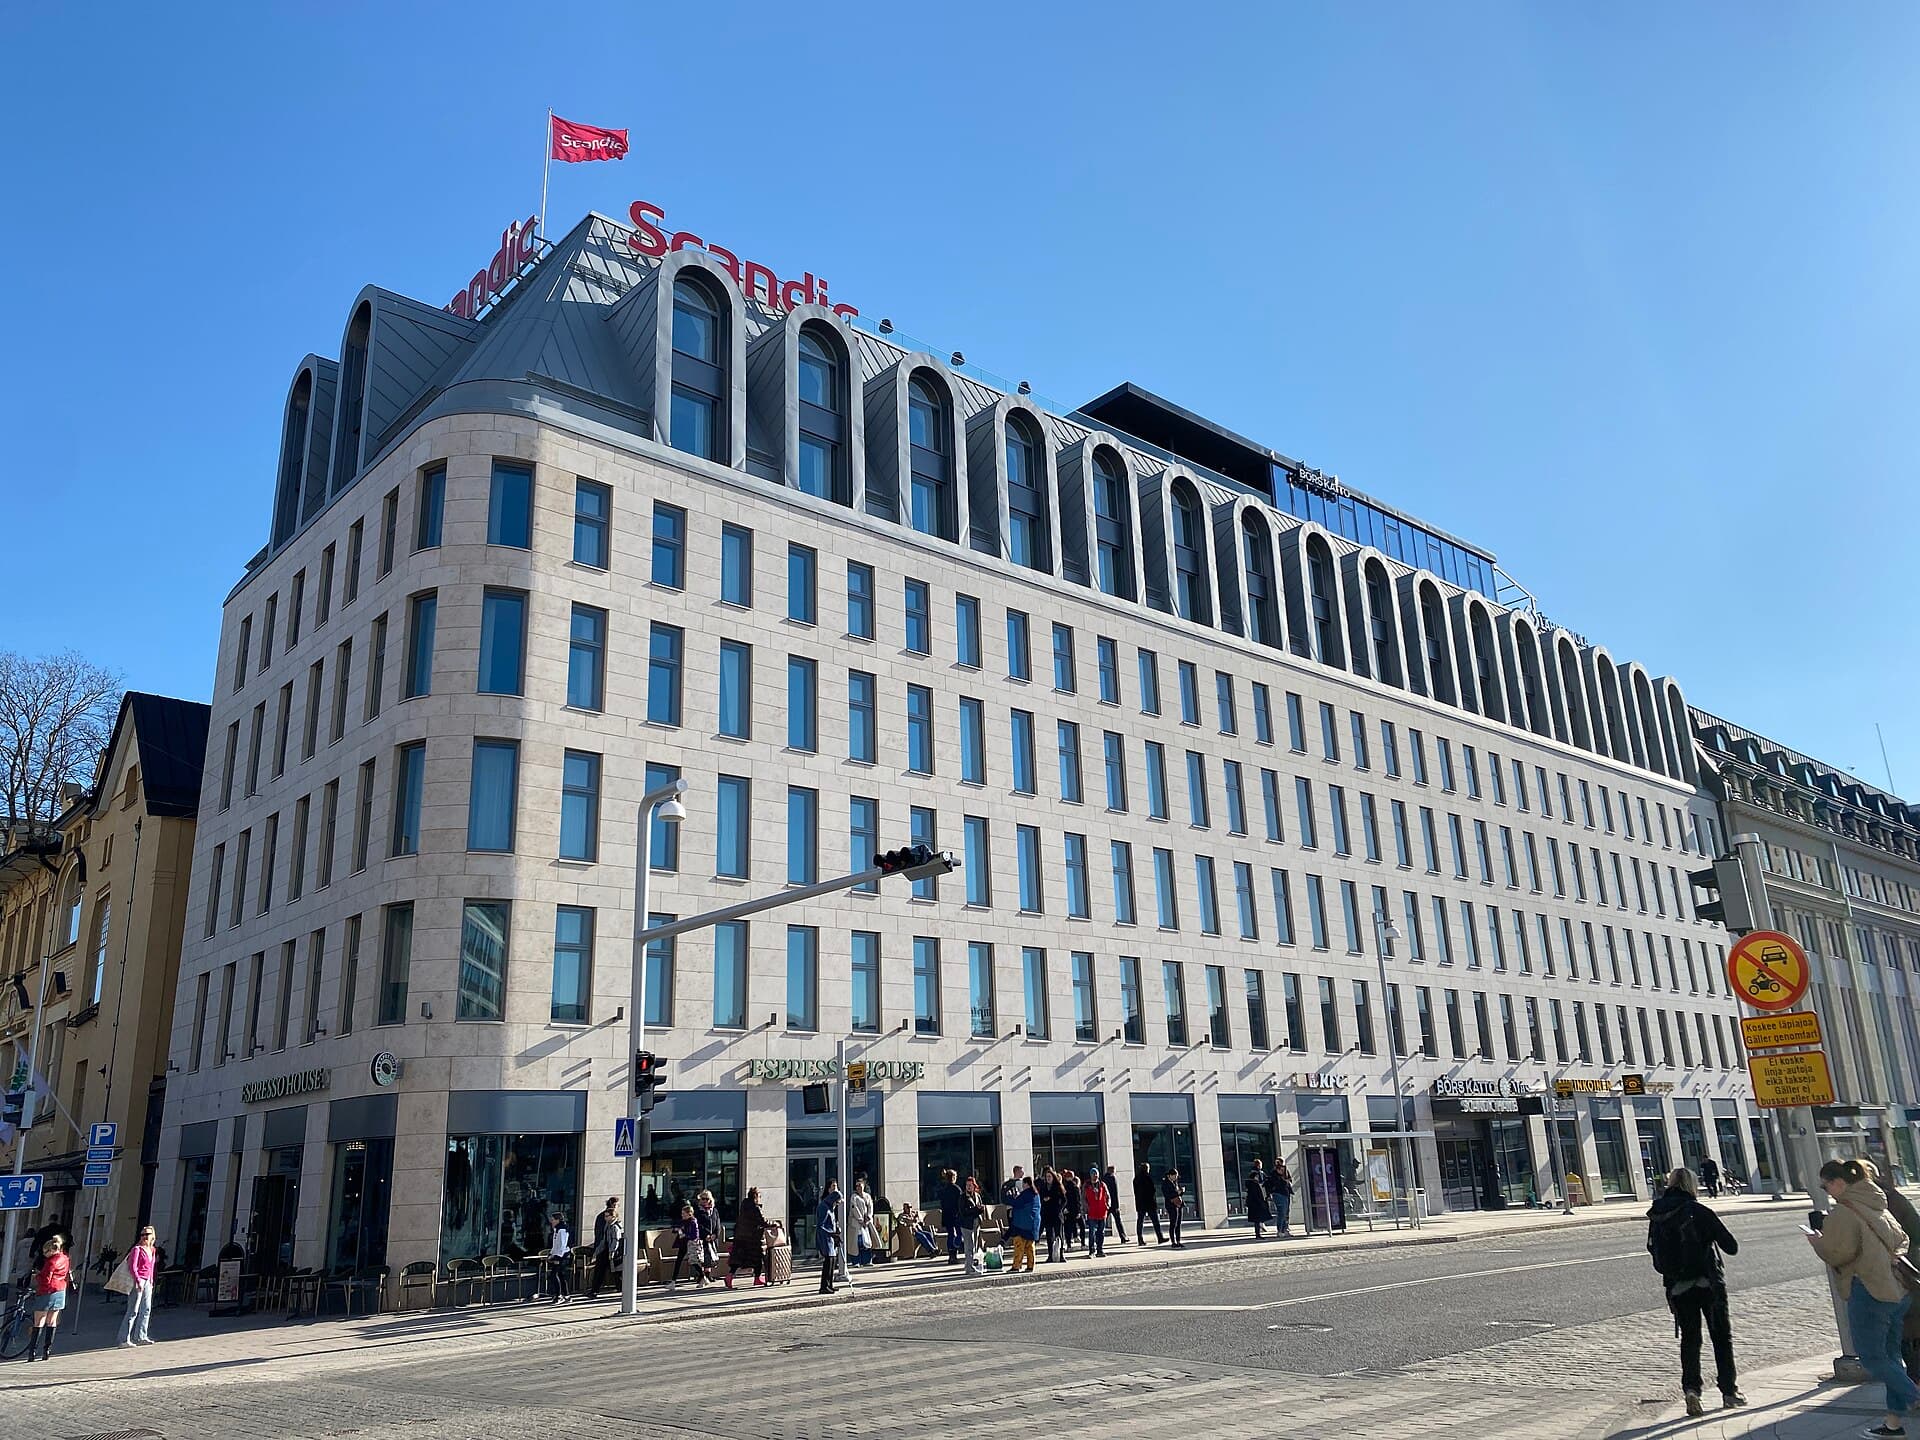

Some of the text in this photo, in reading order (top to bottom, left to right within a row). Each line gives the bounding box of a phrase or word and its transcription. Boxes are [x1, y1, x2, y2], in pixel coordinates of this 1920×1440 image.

[561, 134, 624, 150] Scandic
[443, 215, 540, 318] andic
[1746, 1022, 1777, 1032] Koskee
[1746, 1030, 1818, 1044] Gäller genomfart
[1769, 1056, 1805, 1066] Ei koske
[751, 1059, 846, 1079] ESPRESS
[1764, 1065, 1813, 1076] linja-autoja
[241, 1068, 322, 1103] ESPRESSO HOUSE
[1319, 1073, 1346, 1089] KFC
[1766, 1074, 1816, 1086] eikä takseja
[1775, 1085, 1810, 1095] Gäller ej
[1760, 1092, 1829, 1105] bussar eller taxi
[95, 1125, 112, 1145] P
